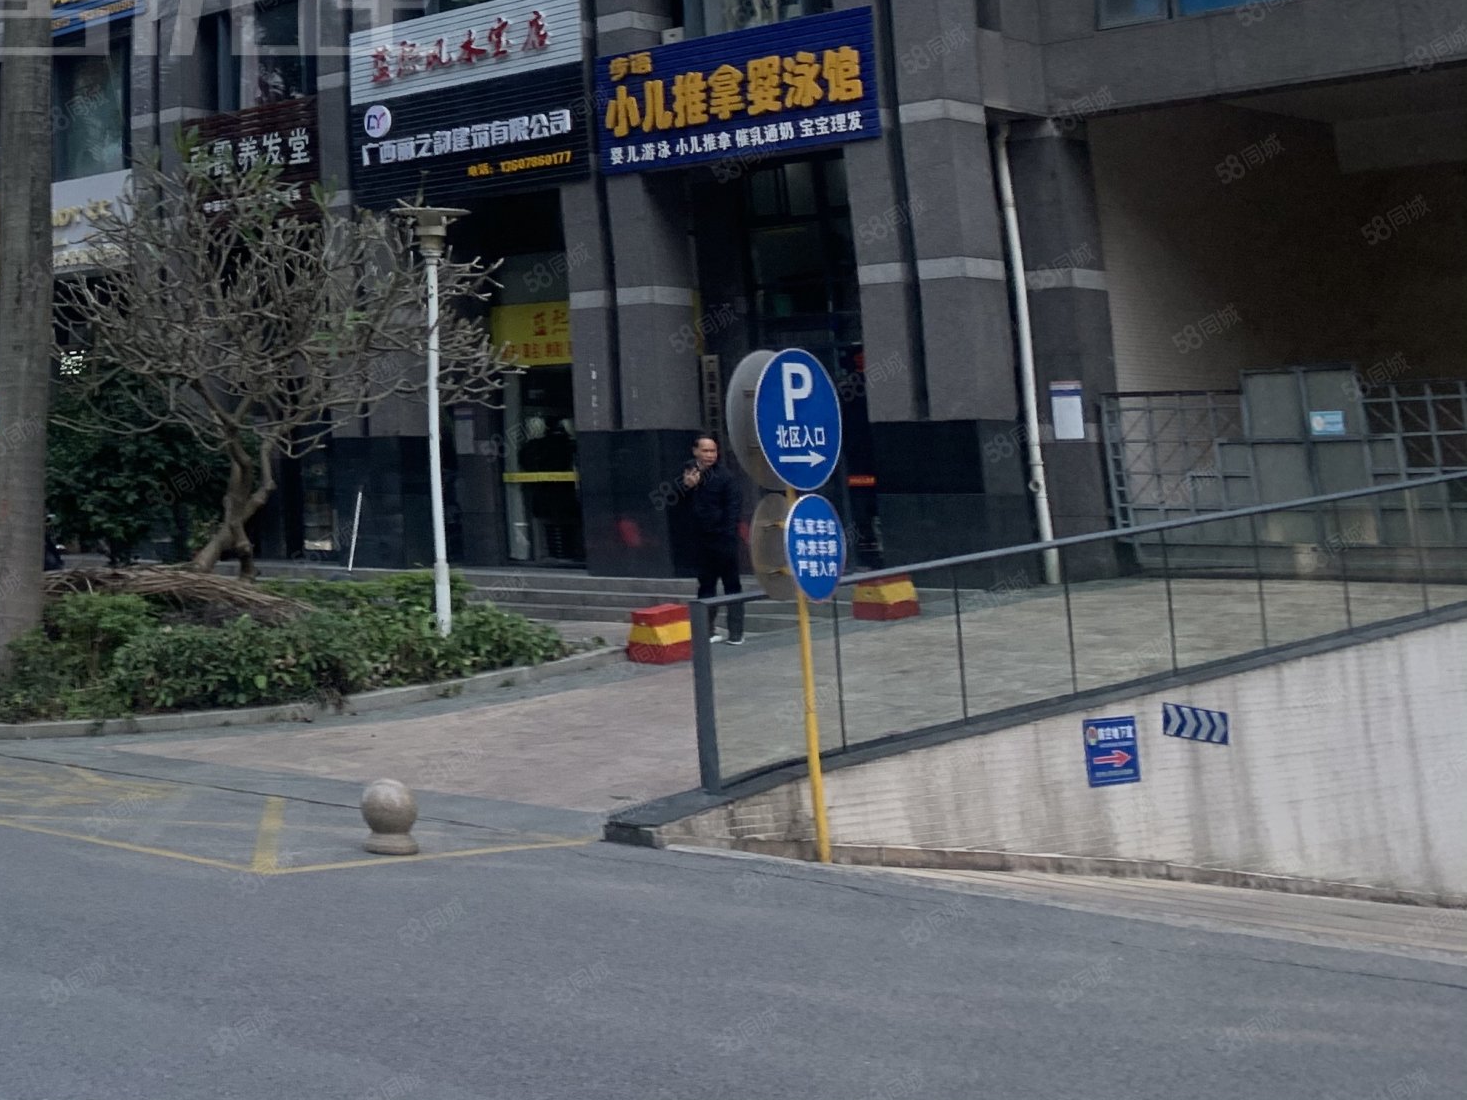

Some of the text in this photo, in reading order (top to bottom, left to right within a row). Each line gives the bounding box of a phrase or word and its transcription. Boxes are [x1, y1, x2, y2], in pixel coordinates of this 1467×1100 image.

[605, 46, 864, 138] 小儿推拿婴泳馆
[610, 111, 863, 165] 婴儿游泳 小儿推拿 催乳通奶 宝宝理发
[781, 362, 813, 421] P
[776, 425, 826, 448] 北区入口
[793, 518, 837, 536] 私家车位
[798, 561, 838, 578] 严禁入内
